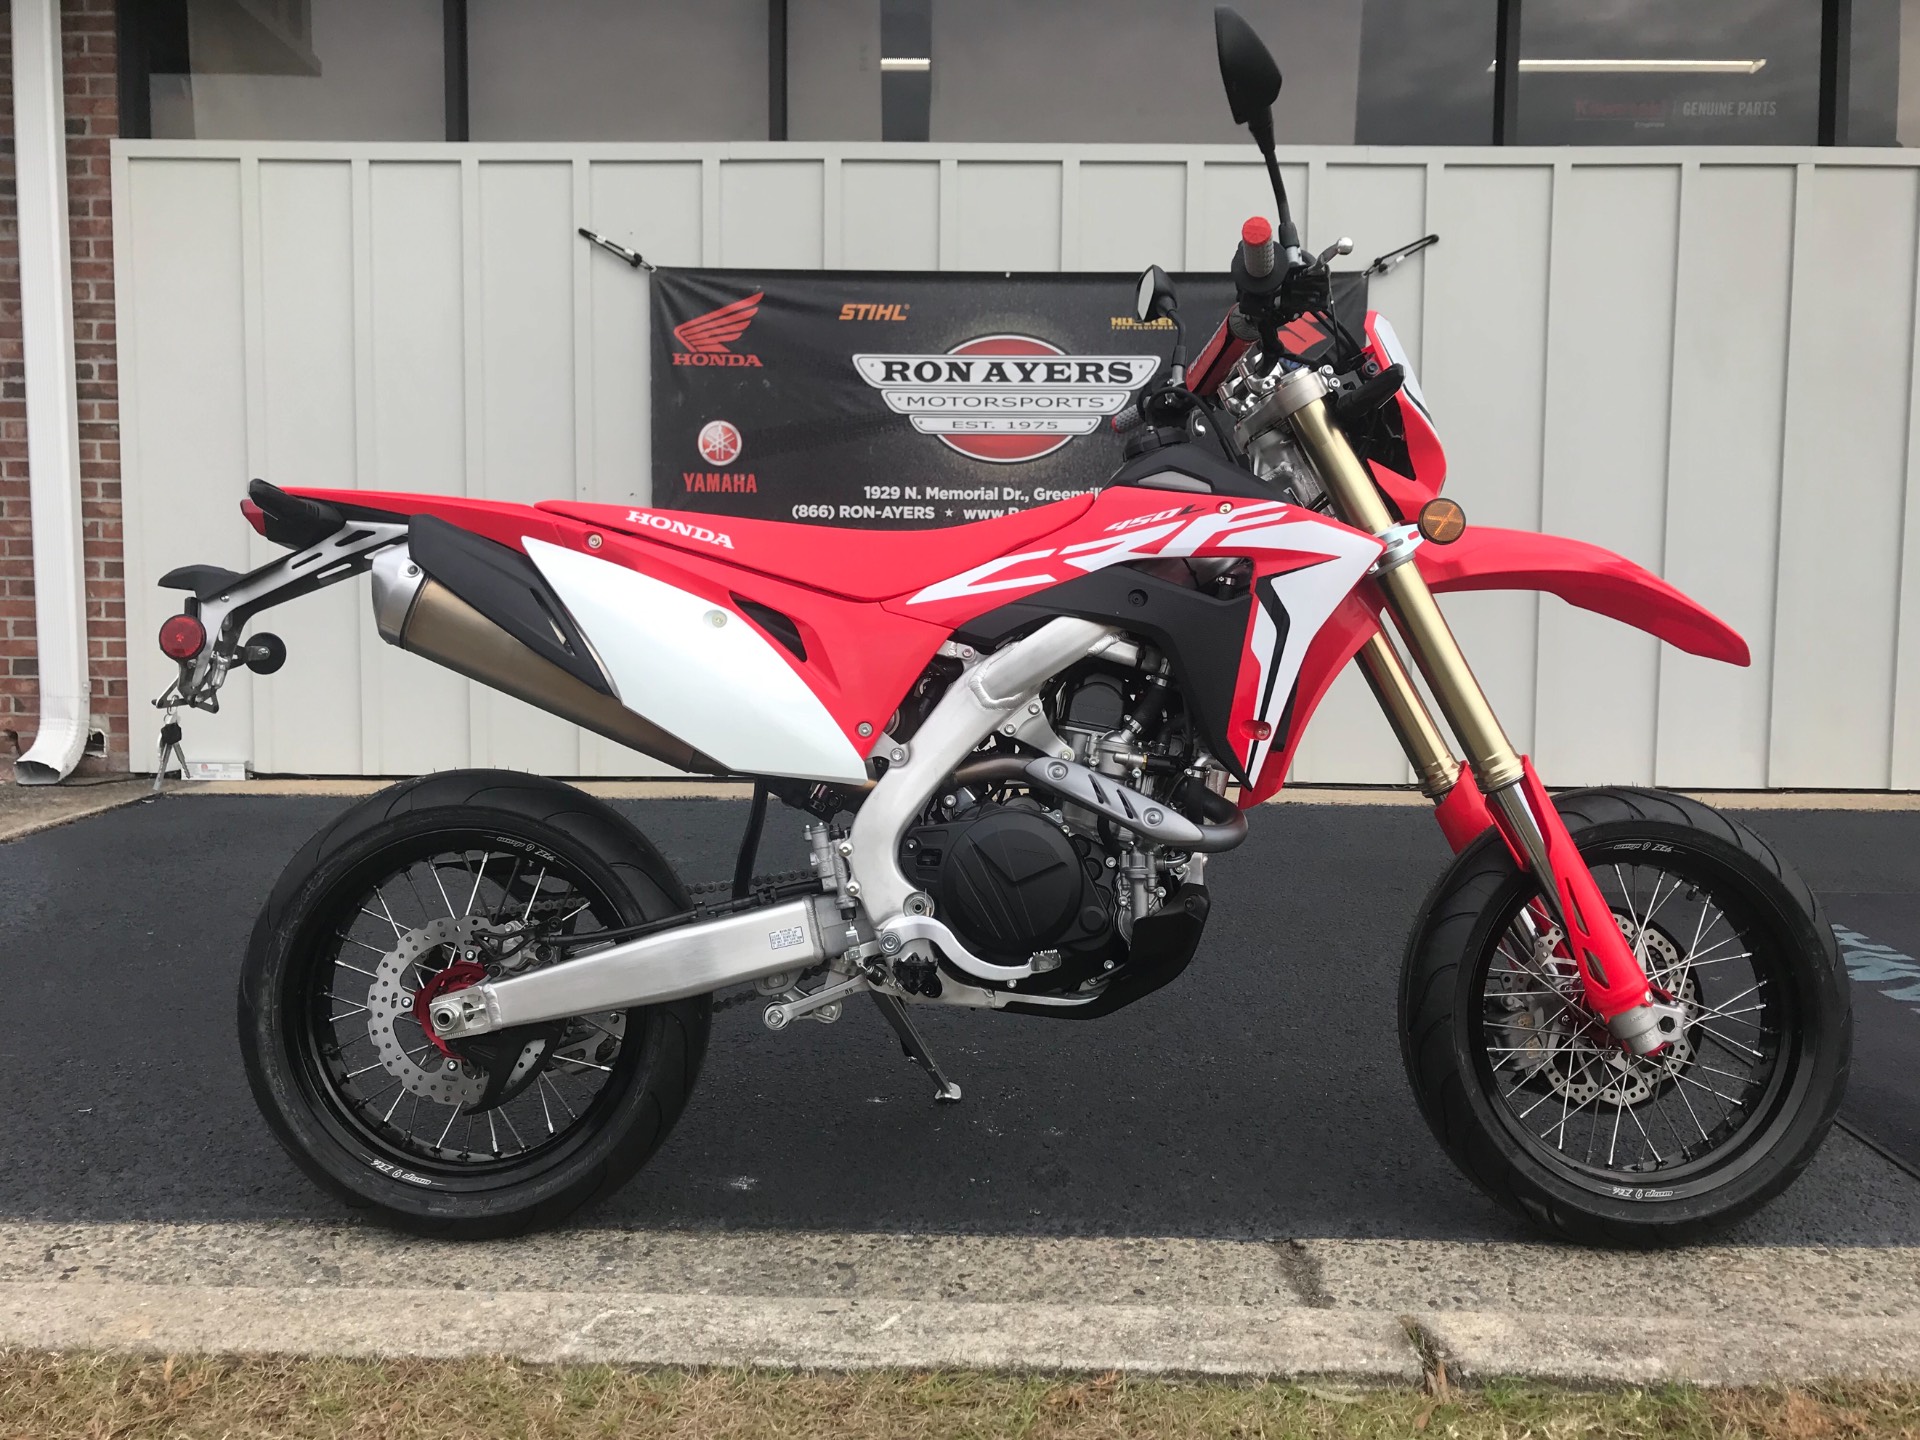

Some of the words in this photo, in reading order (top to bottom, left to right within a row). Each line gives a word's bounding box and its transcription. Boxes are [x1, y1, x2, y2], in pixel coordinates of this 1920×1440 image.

[1682, 100, 1736, 117] GENUINE
[1738, 100, 1777, 116] PARTS
[839, 303, 907, 321] STIHL
[672, 353, 764, 367] HONDA
[880, 361, 975, 383] RON
[981, 361, 1133, 384] AYERS
[906, 396, 1104, 408] MOTORSPORTS
[952, 420, 995, 430] EST.
[1008, 421, 1058, 430] 1975
[683, 473, 757, 493] YAMAHA
[864, 485, 900, 499] 1929
[904, 486, 921, 500] N.
[926, 487, 999, 501] Memorial
[1003, 487, 1029, 502] Dr.,
[792, 505, 835, 520] (866)
[839, 505, 935, 519] RON-AYERS
[626, 510, 735, 549] HONDA
